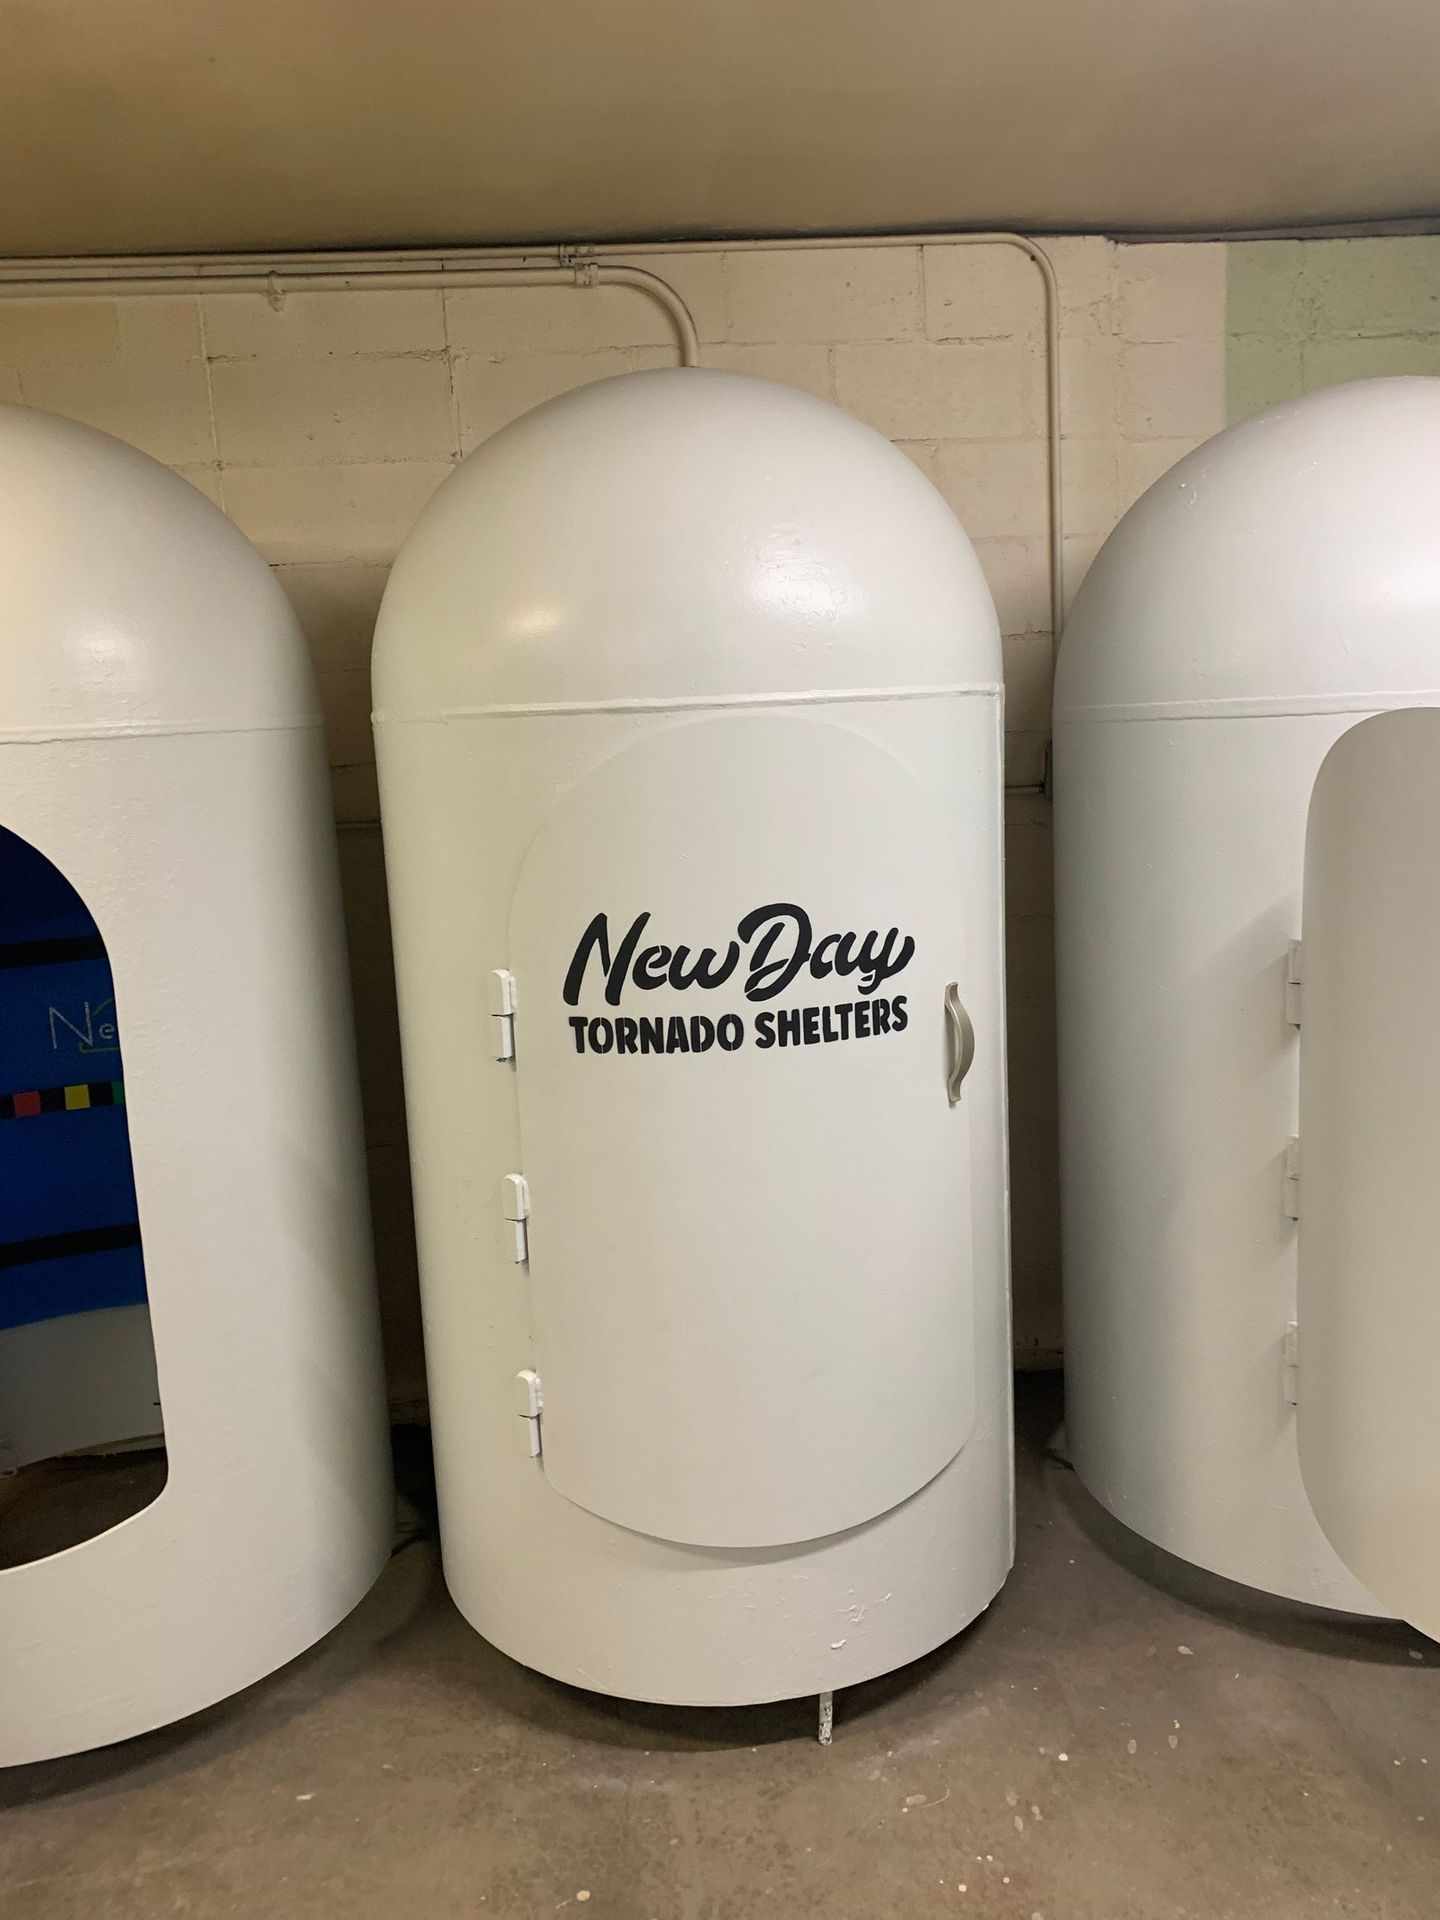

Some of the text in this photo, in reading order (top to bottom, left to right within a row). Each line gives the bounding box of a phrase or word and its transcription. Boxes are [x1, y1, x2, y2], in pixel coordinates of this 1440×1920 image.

[563, 903, 915, 1006] New Day
[568, 995, 908, 1054] TORNADO SHELTERS
